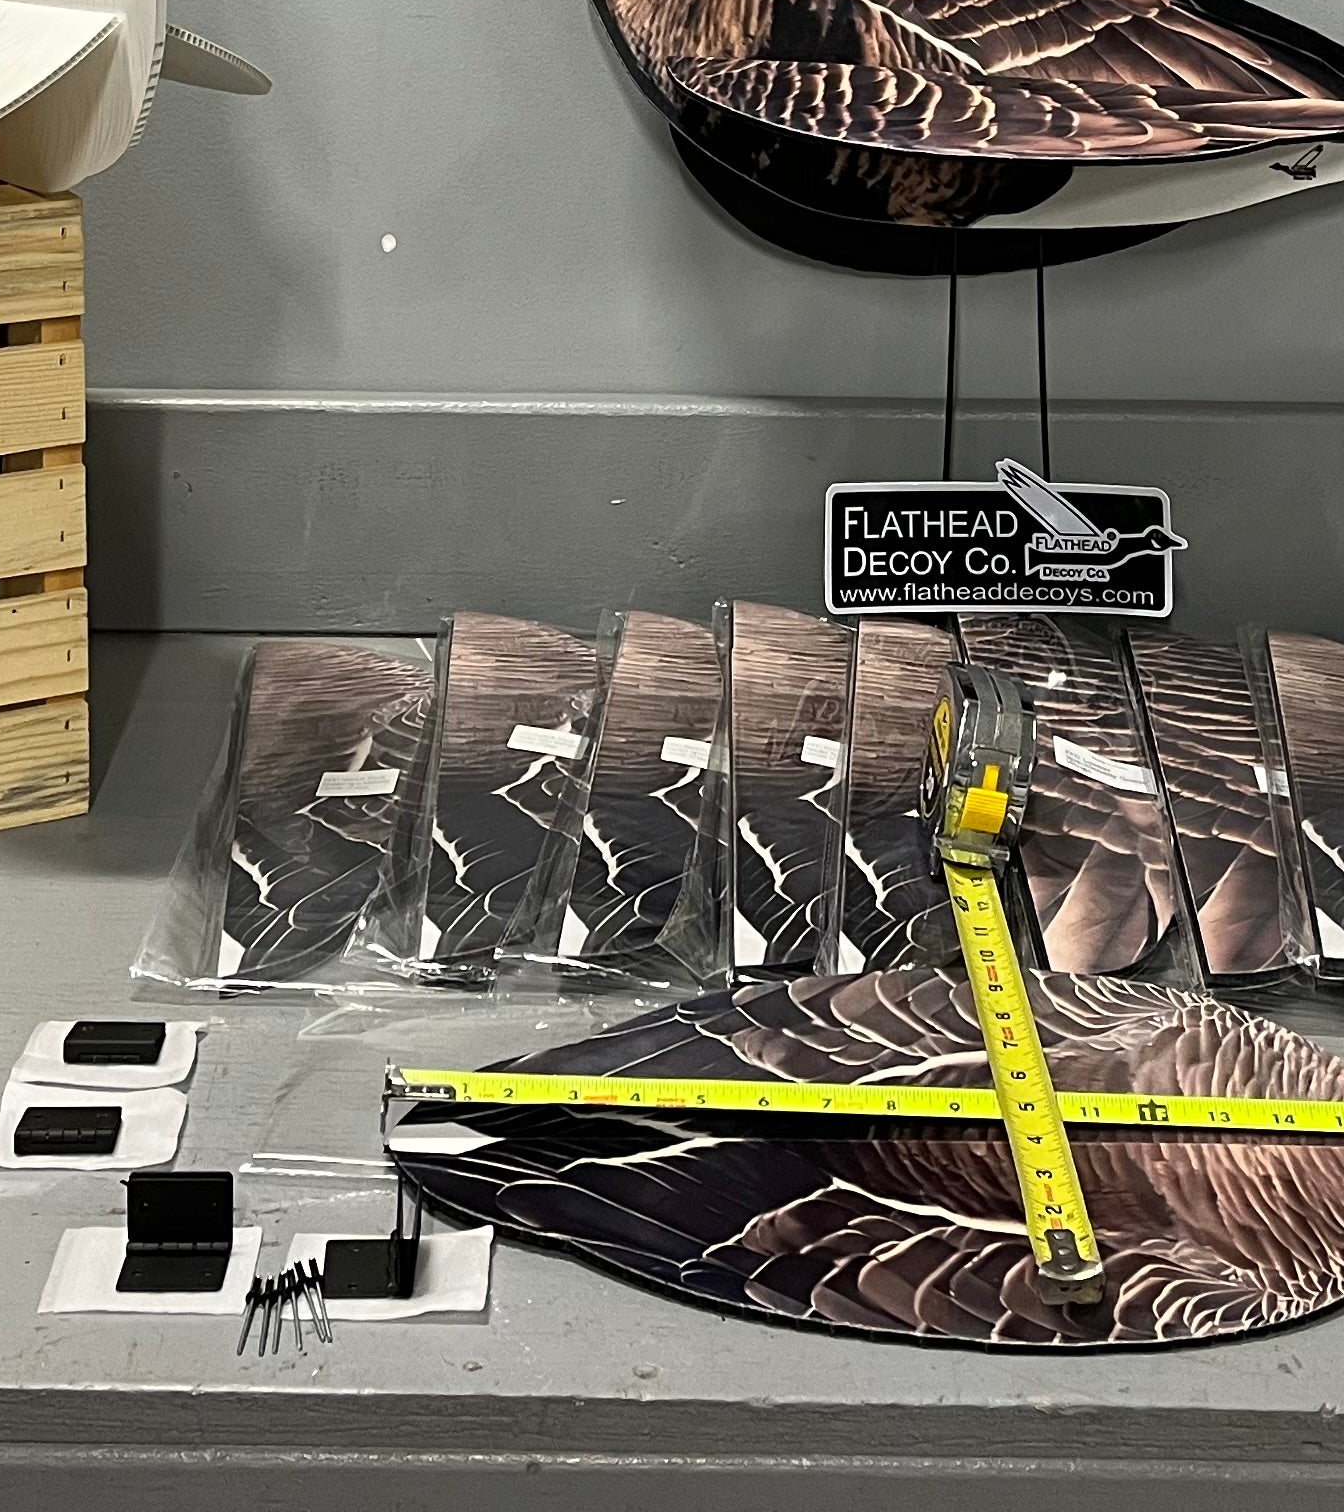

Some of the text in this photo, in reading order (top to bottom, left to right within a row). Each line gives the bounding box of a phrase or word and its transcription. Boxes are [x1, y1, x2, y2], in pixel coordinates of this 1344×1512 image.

[844, 506, 1018, 539] FLATHEAD
[1035, 537, 1112, 552] FLATHEAD
[844, 548, 1017, 577] DECOY Co.
[1043, 567, 1083, 578] DECOY
[840, 582, 1154, 606] www.flatheaddecoys.com
[979, 949, 997, 963] 10
[995, 1012, 1011, 1020] 8
[1002, 1040, 1019, 1049] 7
[503, 1088, 514, 1098] 2
[568, 1090, 579, 1101] 3
[696, 1095, 706, 1105] 5
[758, 1097, 770, 1107] 6
[821, 1098, 833, 1109] 7
[886, 1100, 897, 1111] 8
[1018, 1102, 1035, 1112] 5
[1080, 1107, 1100, 1118] 11
[1208, 1111, 1231, 1123] 13
[1272, 1113, 1296, 1125] 14
[1026, 1135, 1043, 1145] 4
[1035, 1169, 1053, 1179] 3
[1045, 1204, 1063, 1215] 2
